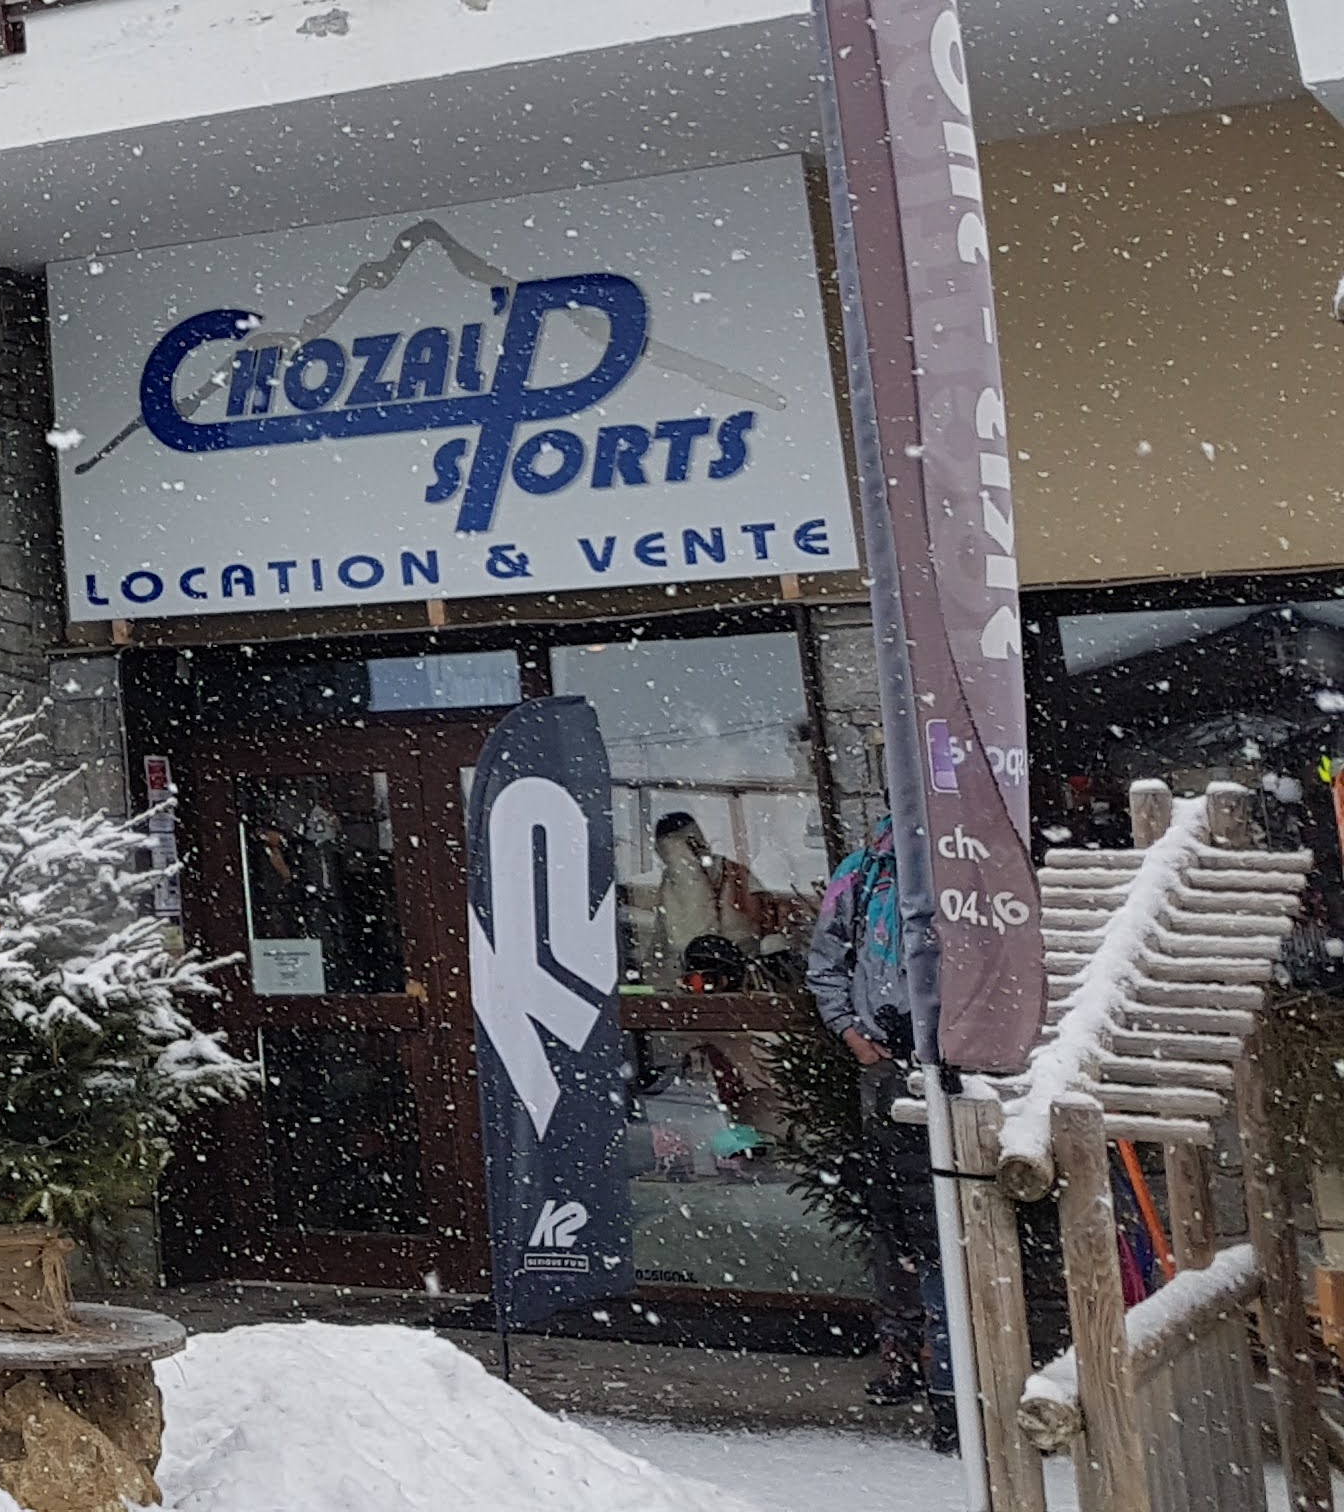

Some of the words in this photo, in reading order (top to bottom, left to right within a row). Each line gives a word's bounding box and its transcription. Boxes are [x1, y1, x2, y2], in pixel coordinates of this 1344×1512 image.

[425, 410, 755, 533] SPORTS
[86, 549, 441, 606] LOCATION
[485, 543, 532, 579] &
[578, 518, 831, 572] VENTE
[528, 1199, 589, 1247] K2
